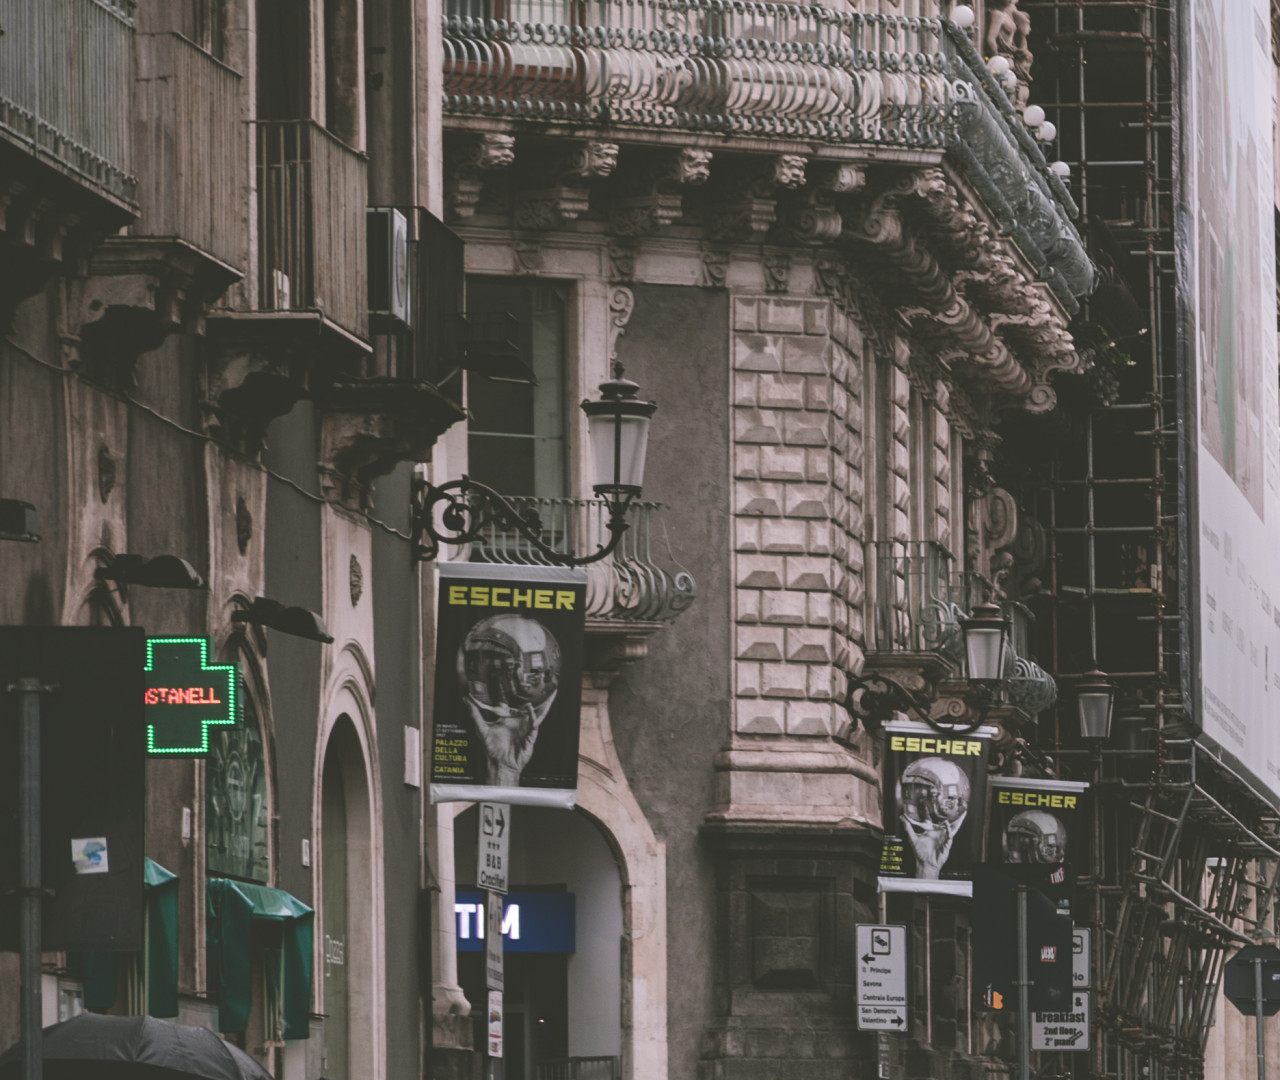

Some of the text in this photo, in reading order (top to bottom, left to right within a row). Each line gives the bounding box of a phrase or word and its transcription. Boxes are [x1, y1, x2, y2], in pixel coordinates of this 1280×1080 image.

[448, 585, 577, 611] ESCHER
[890, 736, 981, 756] ESCHER
[998, 791, 1077, 809] ESCHER
[486, 854, 502, 869] B&B
[863, 980, 882, 988] Savona
[887, 994, 905, 1002] Europa
[873, 1007, 897, 1015] Demetrio
[862, 1016, 887, 1024] Valentino
[1035, 1012, 1085, 1024] Breakfast
[1044, 1026, 1076, 1036] 2nd floor
